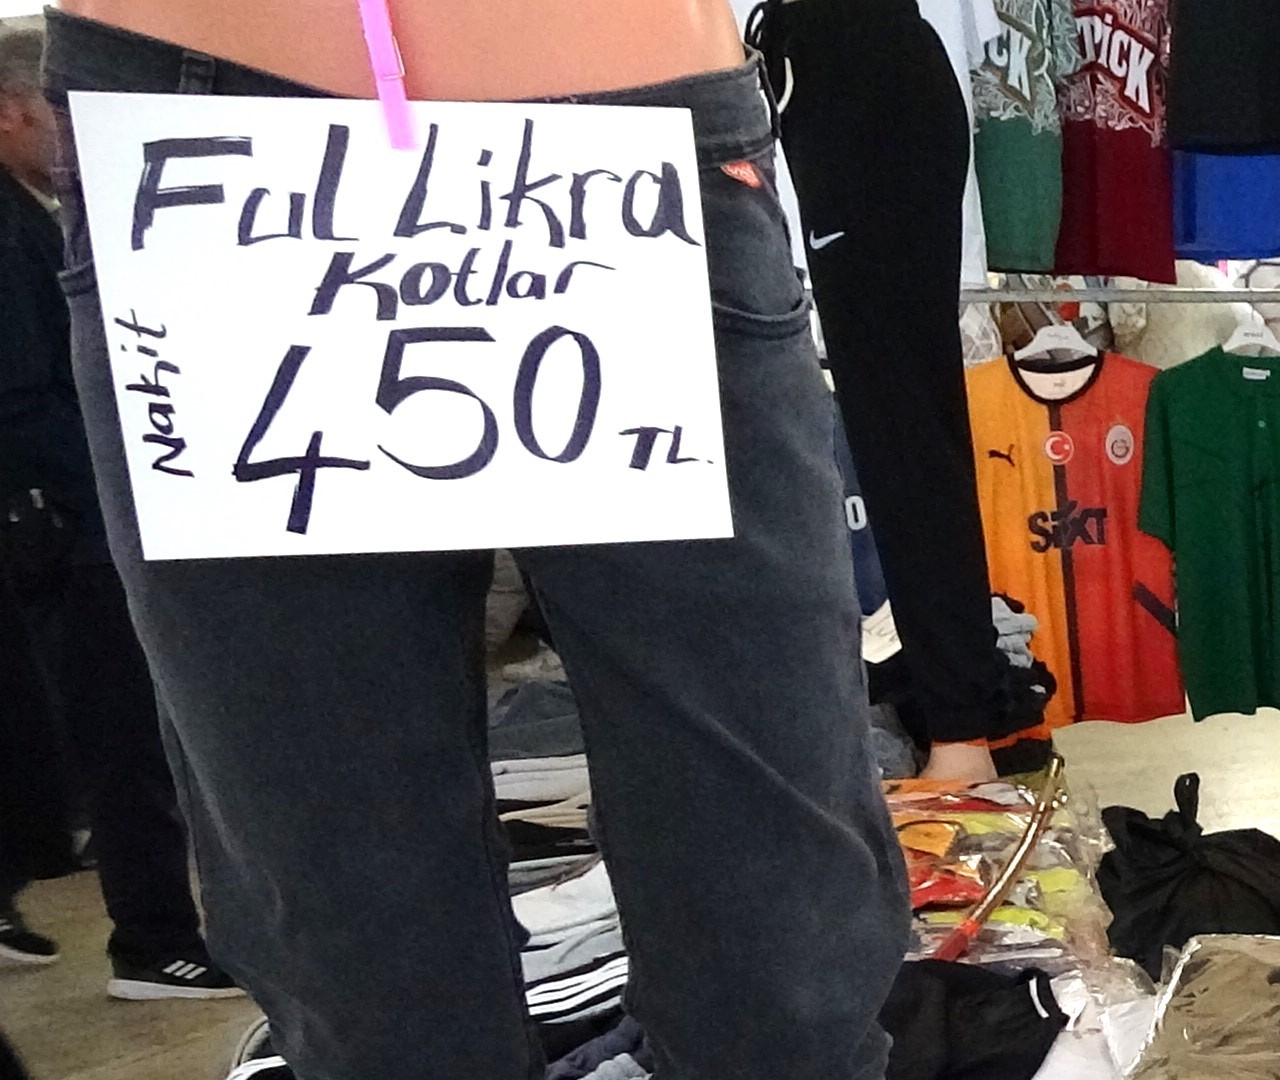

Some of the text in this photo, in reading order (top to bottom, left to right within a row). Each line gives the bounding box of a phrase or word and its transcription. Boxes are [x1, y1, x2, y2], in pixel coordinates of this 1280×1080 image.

[394, 119, 702, 248] Likra
[309, 239, 616, 320] Kotlar
[115, 309, 194, 478] Nakit
[232, 325, 602, 535] 450
